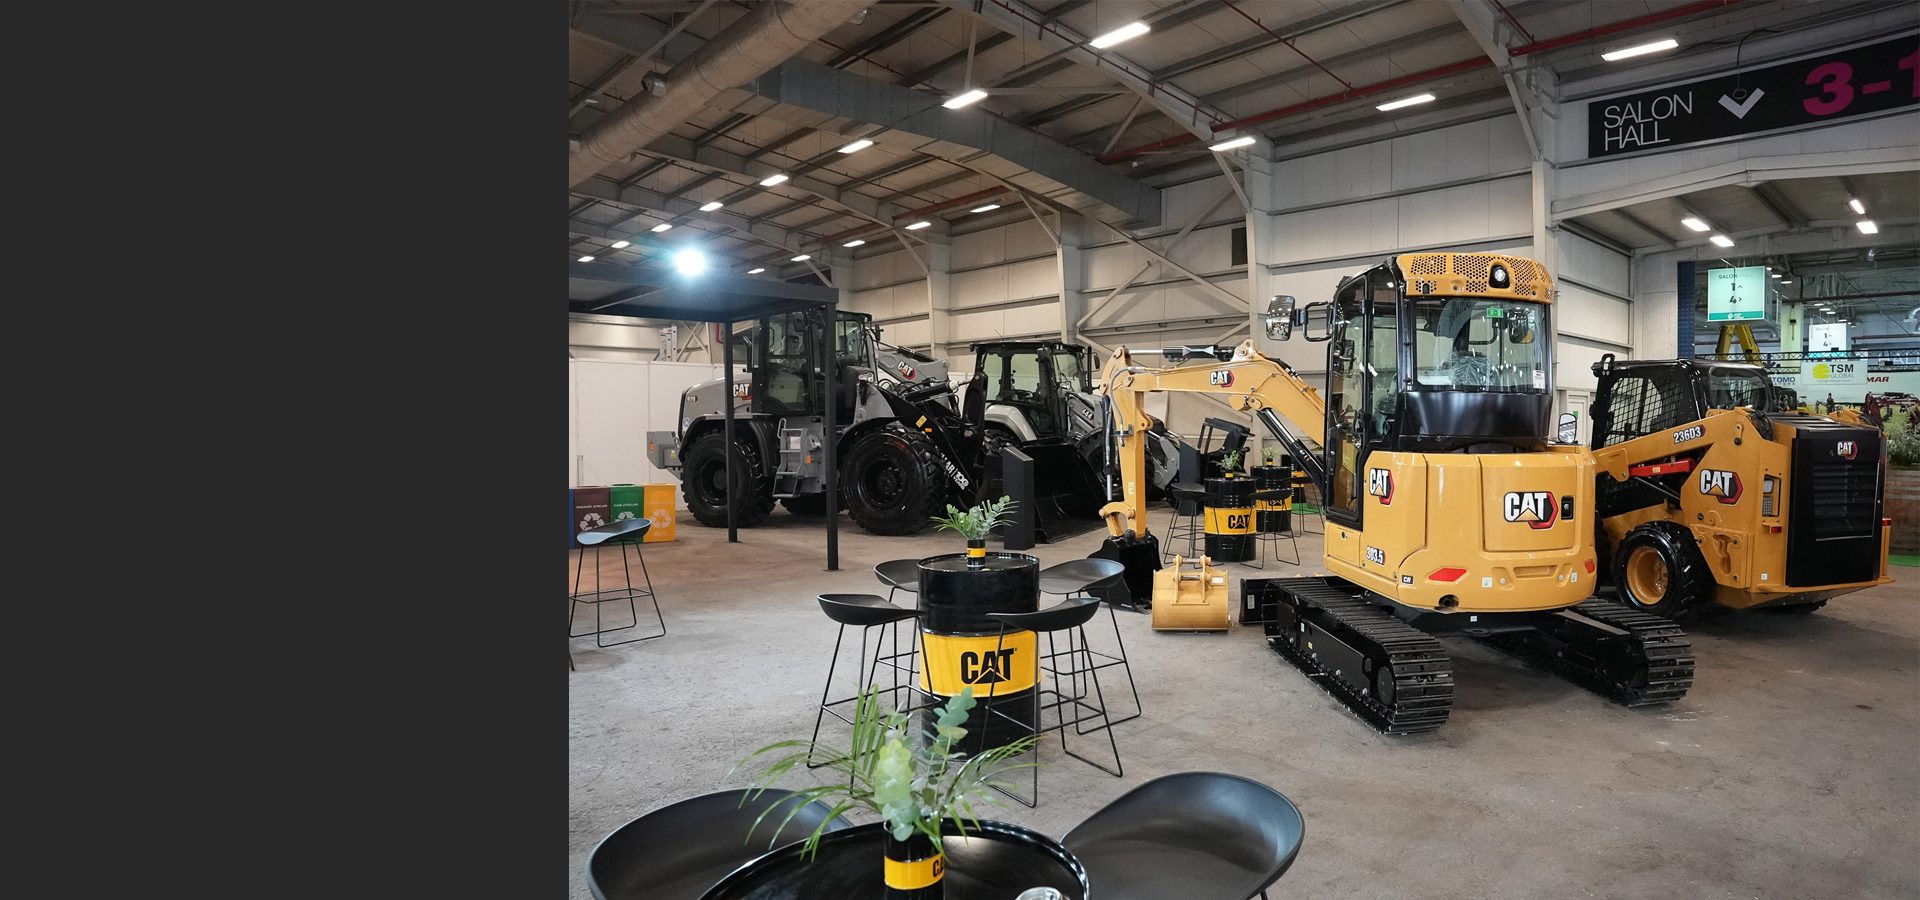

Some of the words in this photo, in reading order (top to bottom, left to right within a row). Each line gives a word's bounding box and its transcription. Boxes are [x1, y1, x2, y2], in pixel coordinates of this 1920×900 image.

[1604, 91, 1692, 129] SALON
[1604, 121, 1670, 151] HALL
[1730, 282, 1736, 291] 1
[1729, 295, 1737, 304] 4
[898, 361, 913, 376] CAT
[1829, 364, 1854, 373] TSM
[1210, 370, 1229, 385] CAT
[733, 383, 750, 397] CAT
[1673, 425, 1702, 444] 236D3
[1837, 441, 1853, 455] CAT
[1369, 468, 1389, 497] CAT
[1700, 469, 1733, 497] CAT
[1504, 492, 1548, 522] CAT
[1227, 514, 1250, 529] CAT
[1366, 546, 1385, 565] 303.5
[960, 648, 1015, 685] CAT
